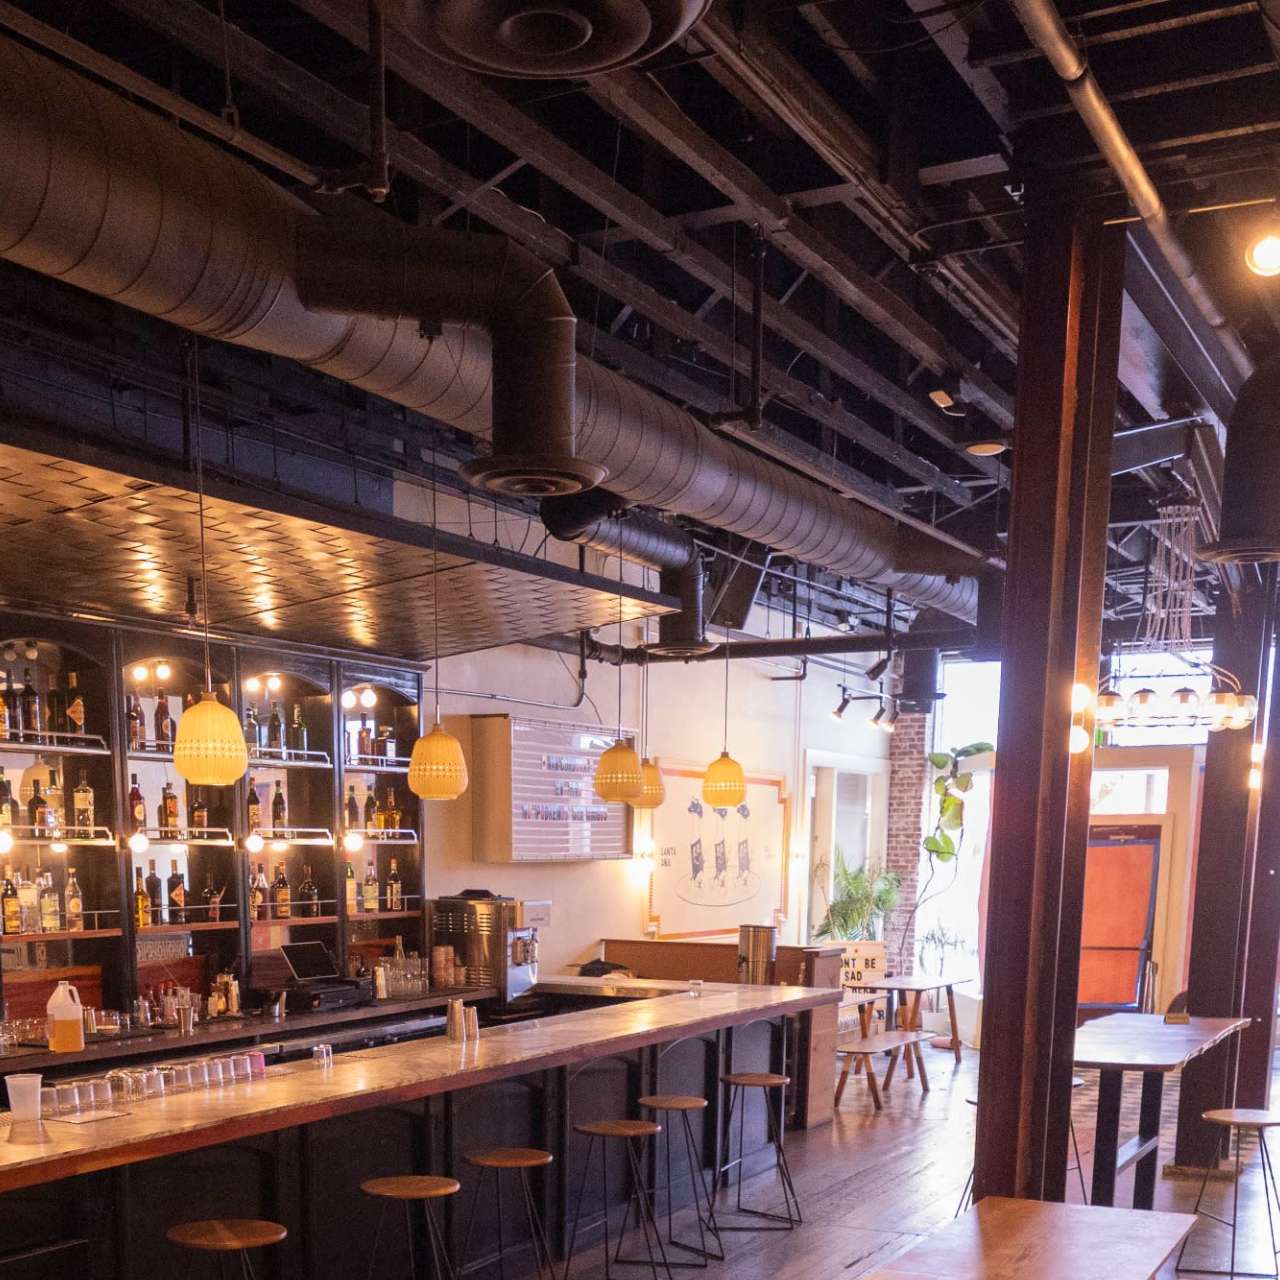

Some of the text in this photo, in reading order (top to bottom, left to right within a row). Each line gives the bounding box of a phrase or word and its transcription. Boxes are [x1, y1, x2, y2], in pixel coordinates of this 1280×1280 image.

[840, 958, 876, 969] ONT BE
[844, 971, 863, 981] SAD
